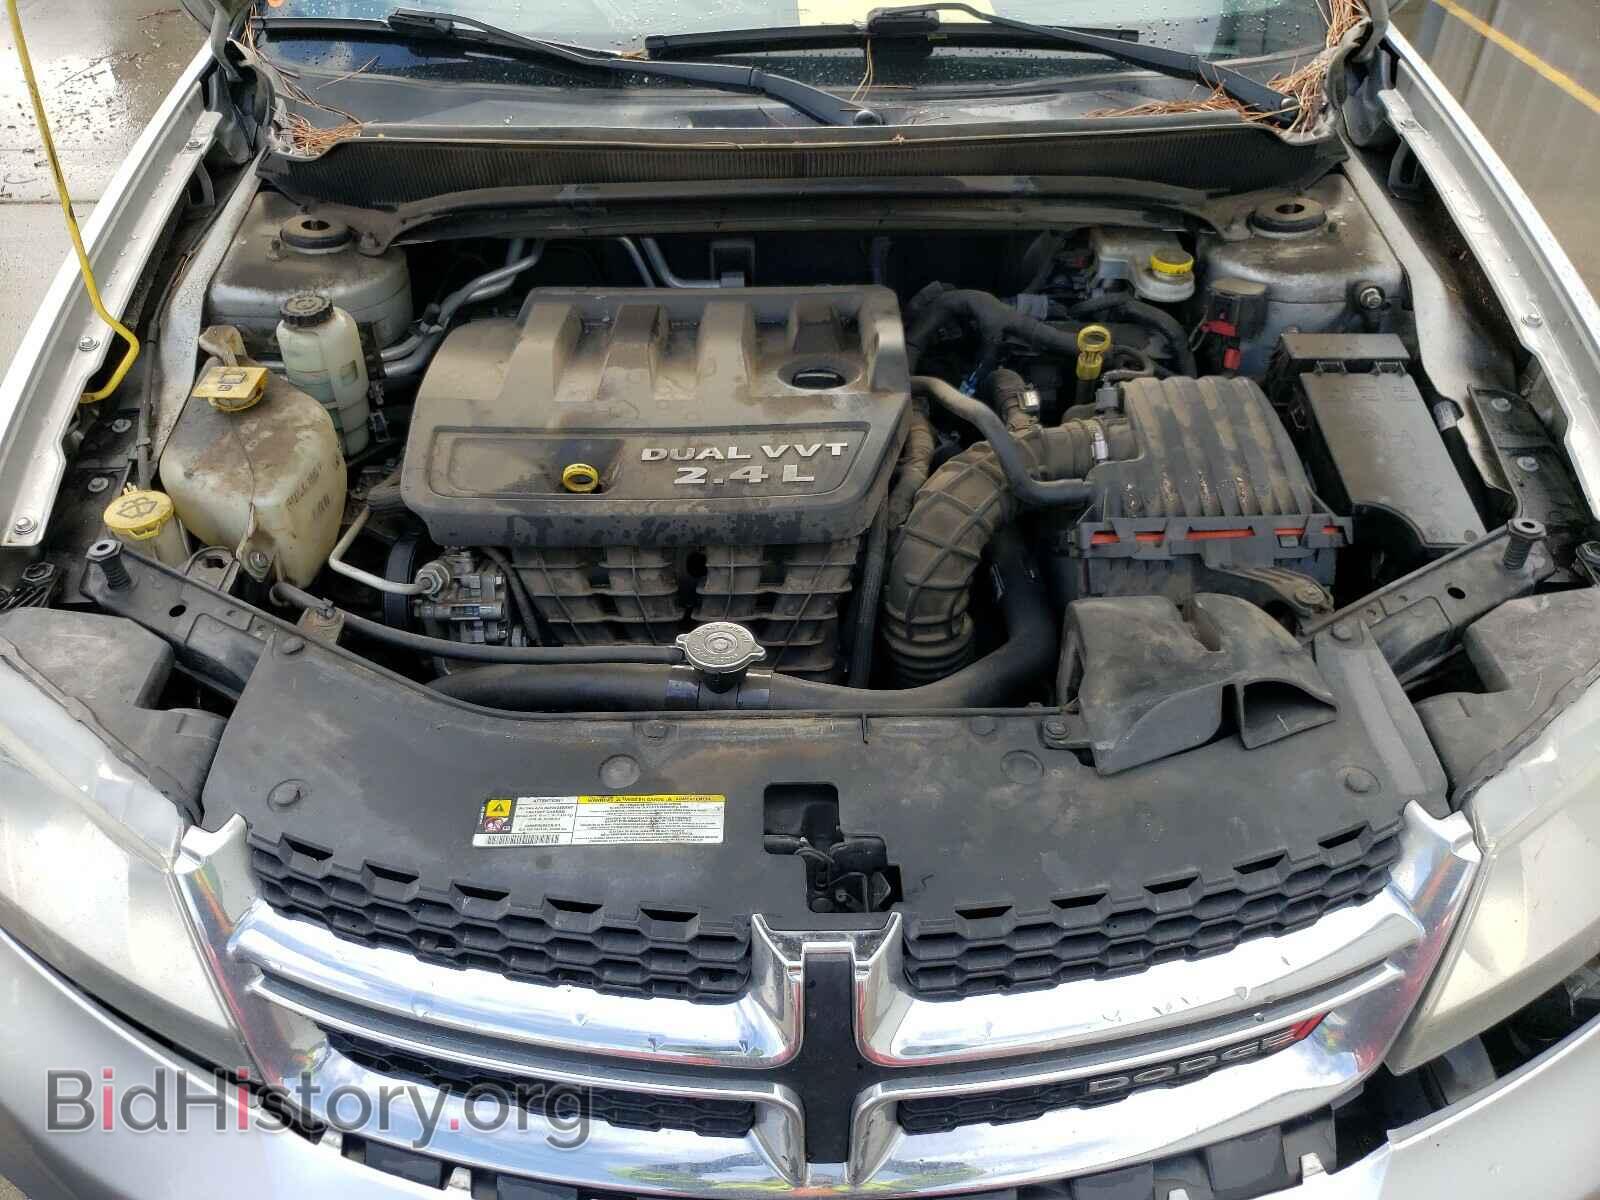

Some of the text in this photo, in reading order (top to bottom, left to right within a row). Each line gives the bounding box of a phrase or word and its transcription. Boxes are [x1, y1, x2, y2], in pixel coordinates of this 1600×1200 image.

[641, 442, 848, 461] DUAL VVT
[674, 464, 815, 485] 2.4 L
[1088, 1028, 1296, 1094] DODGE
